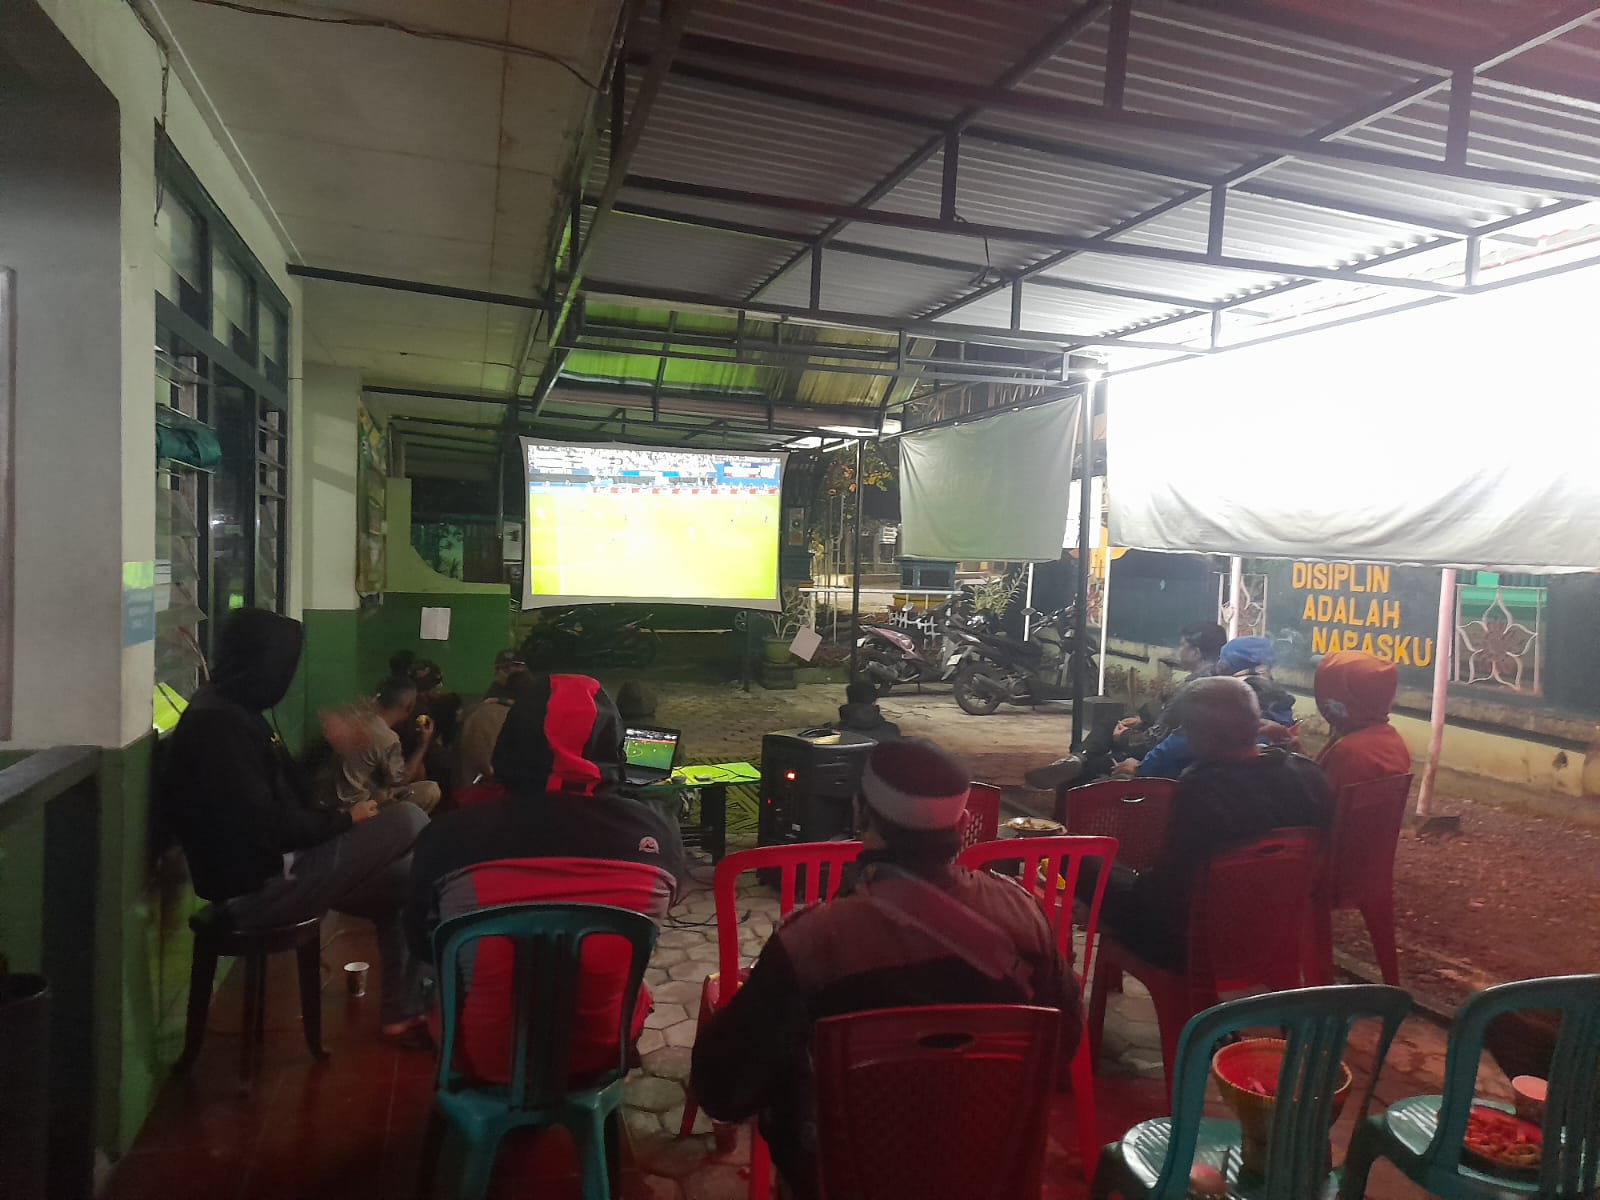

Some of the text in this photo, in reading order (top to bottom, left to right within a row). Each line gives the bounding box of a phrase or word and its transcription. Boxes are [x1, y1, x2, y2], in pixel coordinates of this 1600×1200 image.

[1291, 562, 1391, 593] DISIPLIN
[1302, 594, 1401, 629] ADALAH
[1311, 626, 1433, 667] NAPASKU
